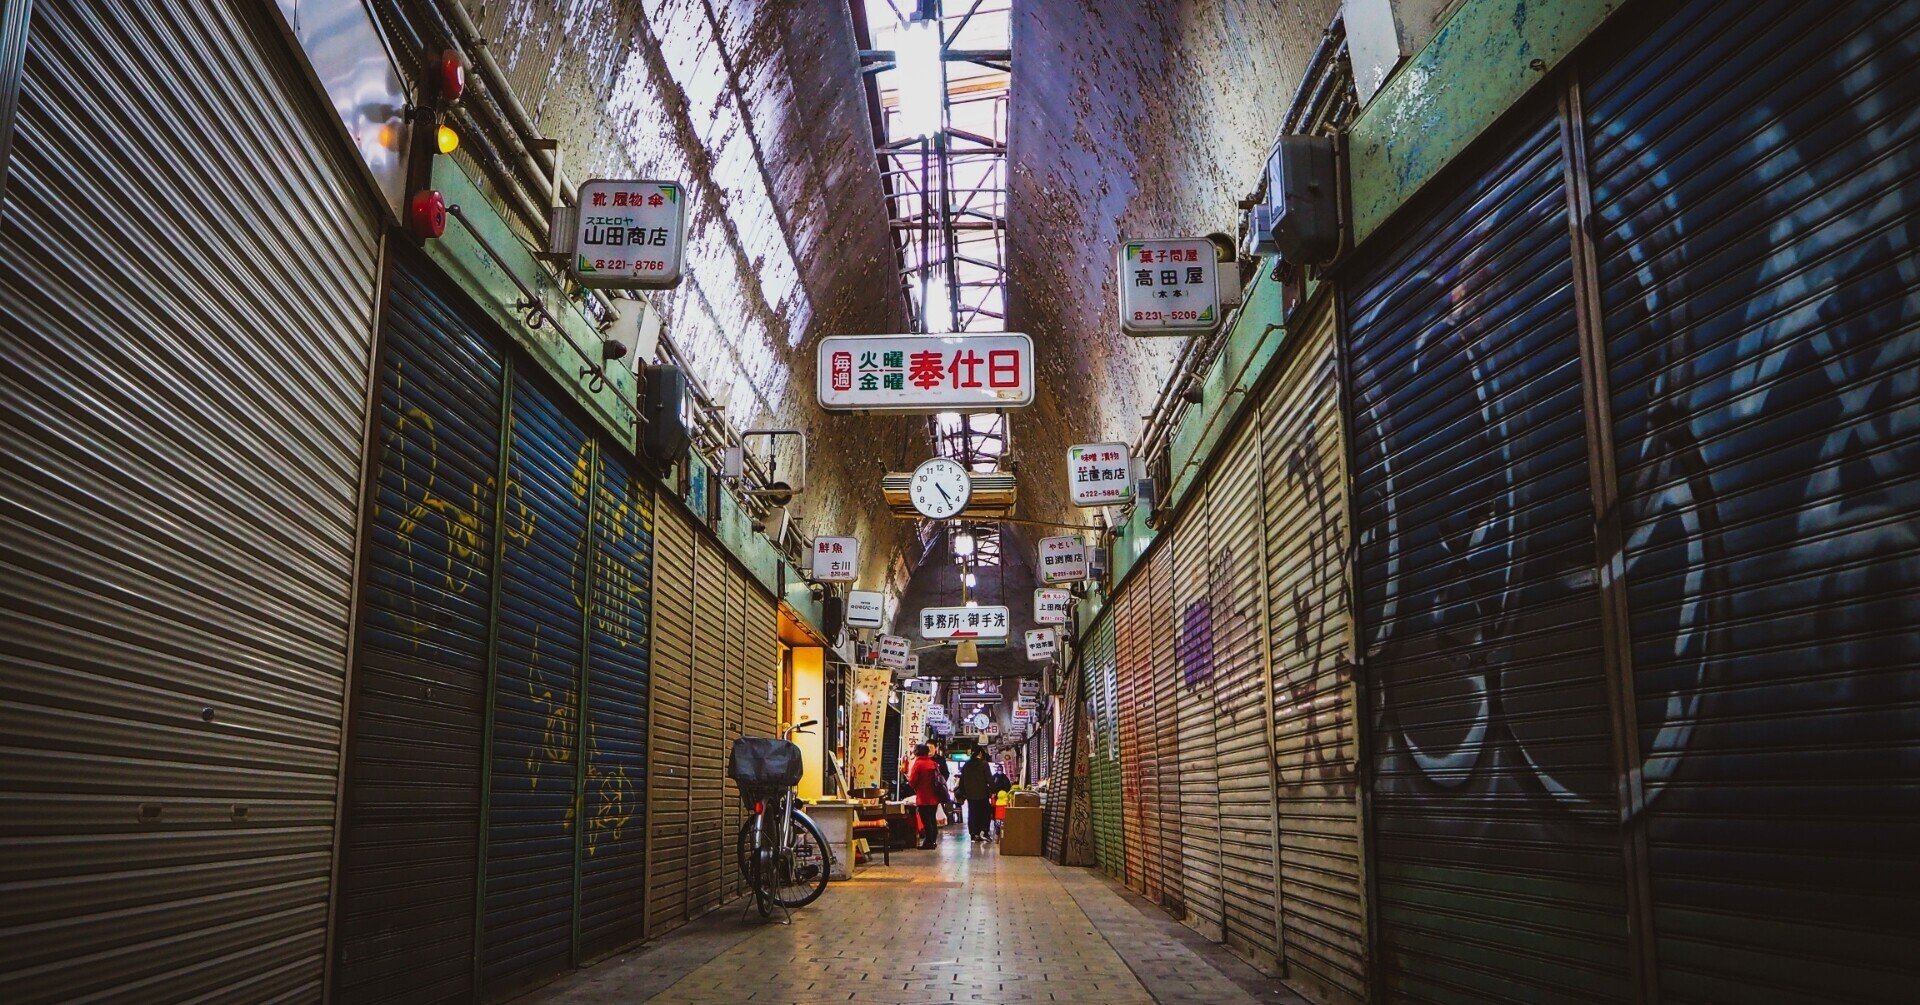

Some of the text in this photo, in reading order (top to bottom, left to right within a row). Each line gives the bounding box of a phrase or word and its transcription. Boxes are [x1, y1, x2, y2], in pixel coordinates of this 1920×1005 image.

[592, 192, 664, 207] 靴 履物 傘
[586, 216, 633, 226] スエヒロヤ
[583, 226, 668, 246] 山田商店
[1139, 249, 1198, 263] 菓子問屋
[1134, 267, 1204, 287] 高田屋
[858, 350, 903, 369] 火曜
[833, 354, 851, 390] 毎週
[908, 350, 1020, 390] 奉仕日
[858, 372, 903, 391] 金曜
[818, 543, 843, 553] 鮮魚
[831, 561, 851, 570] 古川
